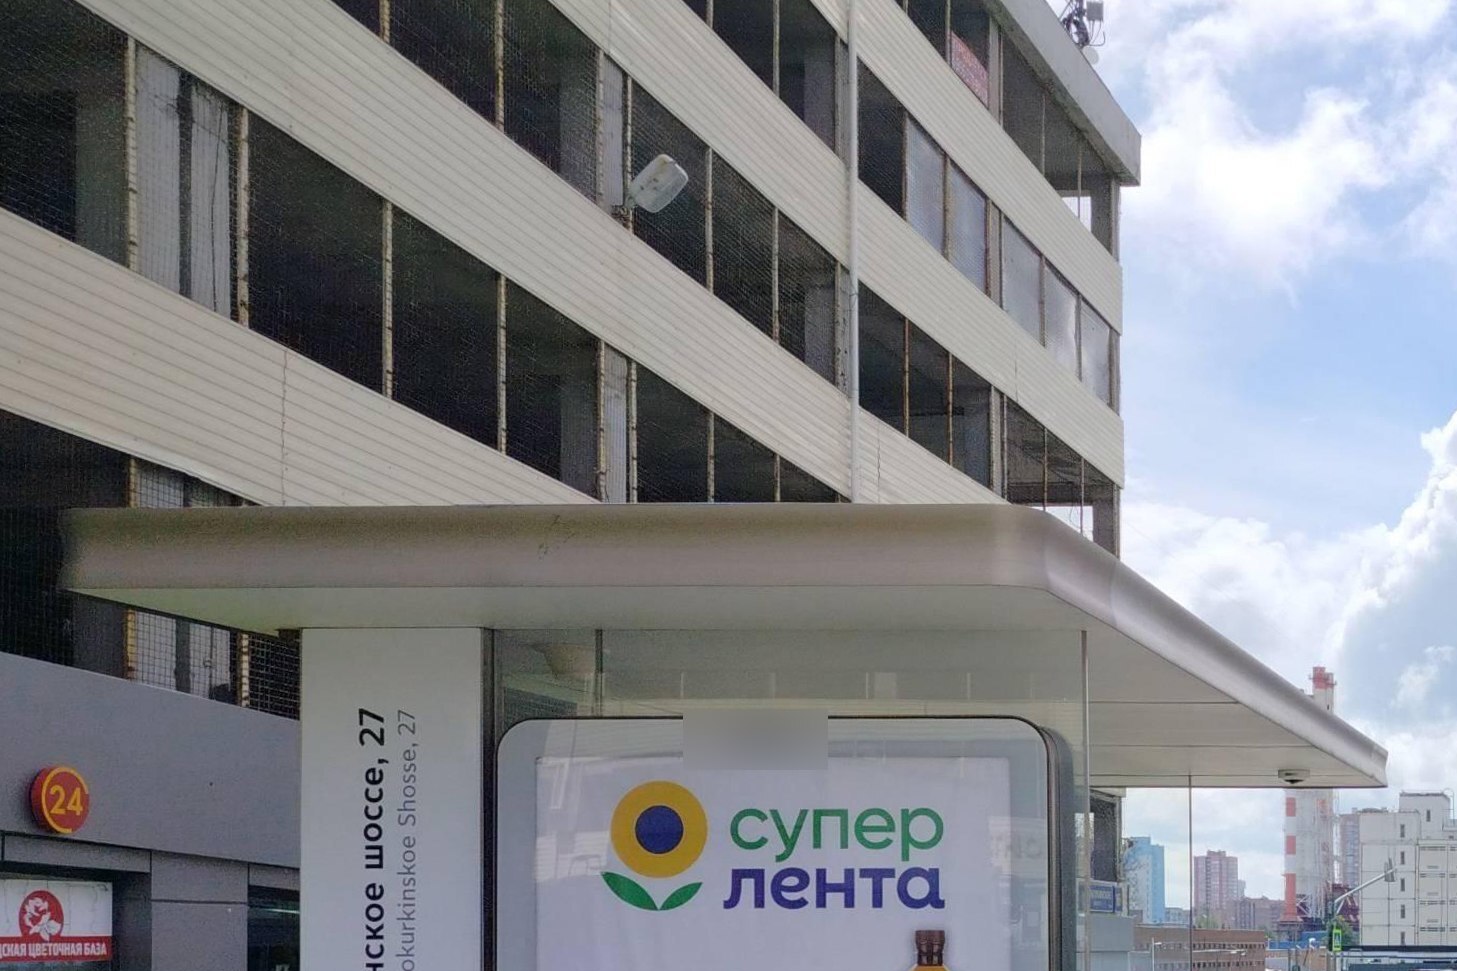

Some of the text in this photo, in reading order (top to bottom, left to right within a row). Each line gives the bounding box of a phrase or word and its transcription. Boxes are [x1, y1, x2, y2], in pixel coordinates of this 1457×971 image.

[358, 708, 384, 746] 27
[397, 709, 416, 735] 27
[49, 785, 83, 816] 24
[397, 743, 418, 827] Shosse,
[363, 758, 389, 869] шоссе,
[730, 807, 944, 862] супер
[723, 866, 945, 910] лента
[29, 943, 82, 958] ЦВЕТОЧНАЯ
[83, 942, 107, 955] БАЗА
